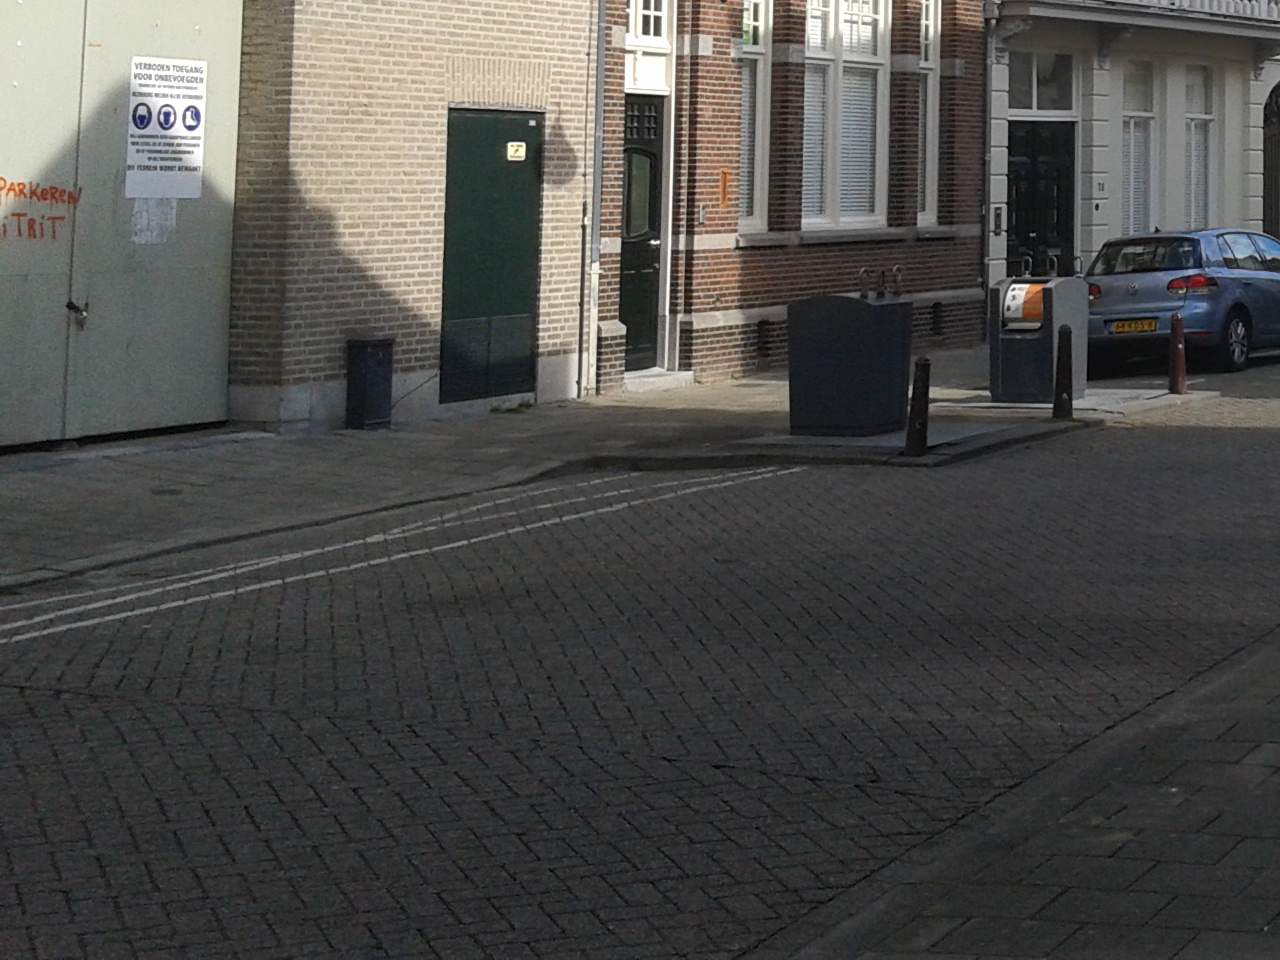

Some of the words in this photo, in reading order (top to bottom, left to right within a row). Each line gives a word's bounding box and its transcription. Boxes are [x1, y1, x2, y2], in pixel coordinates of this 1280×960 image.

[134, 62, 171, 72] VERBODEN
[172, 65, 204, 74] TOEGANG
[133, 72, 153, 81] VOOR
[154, 73, 204, 84] ONBEVOEGDEN
